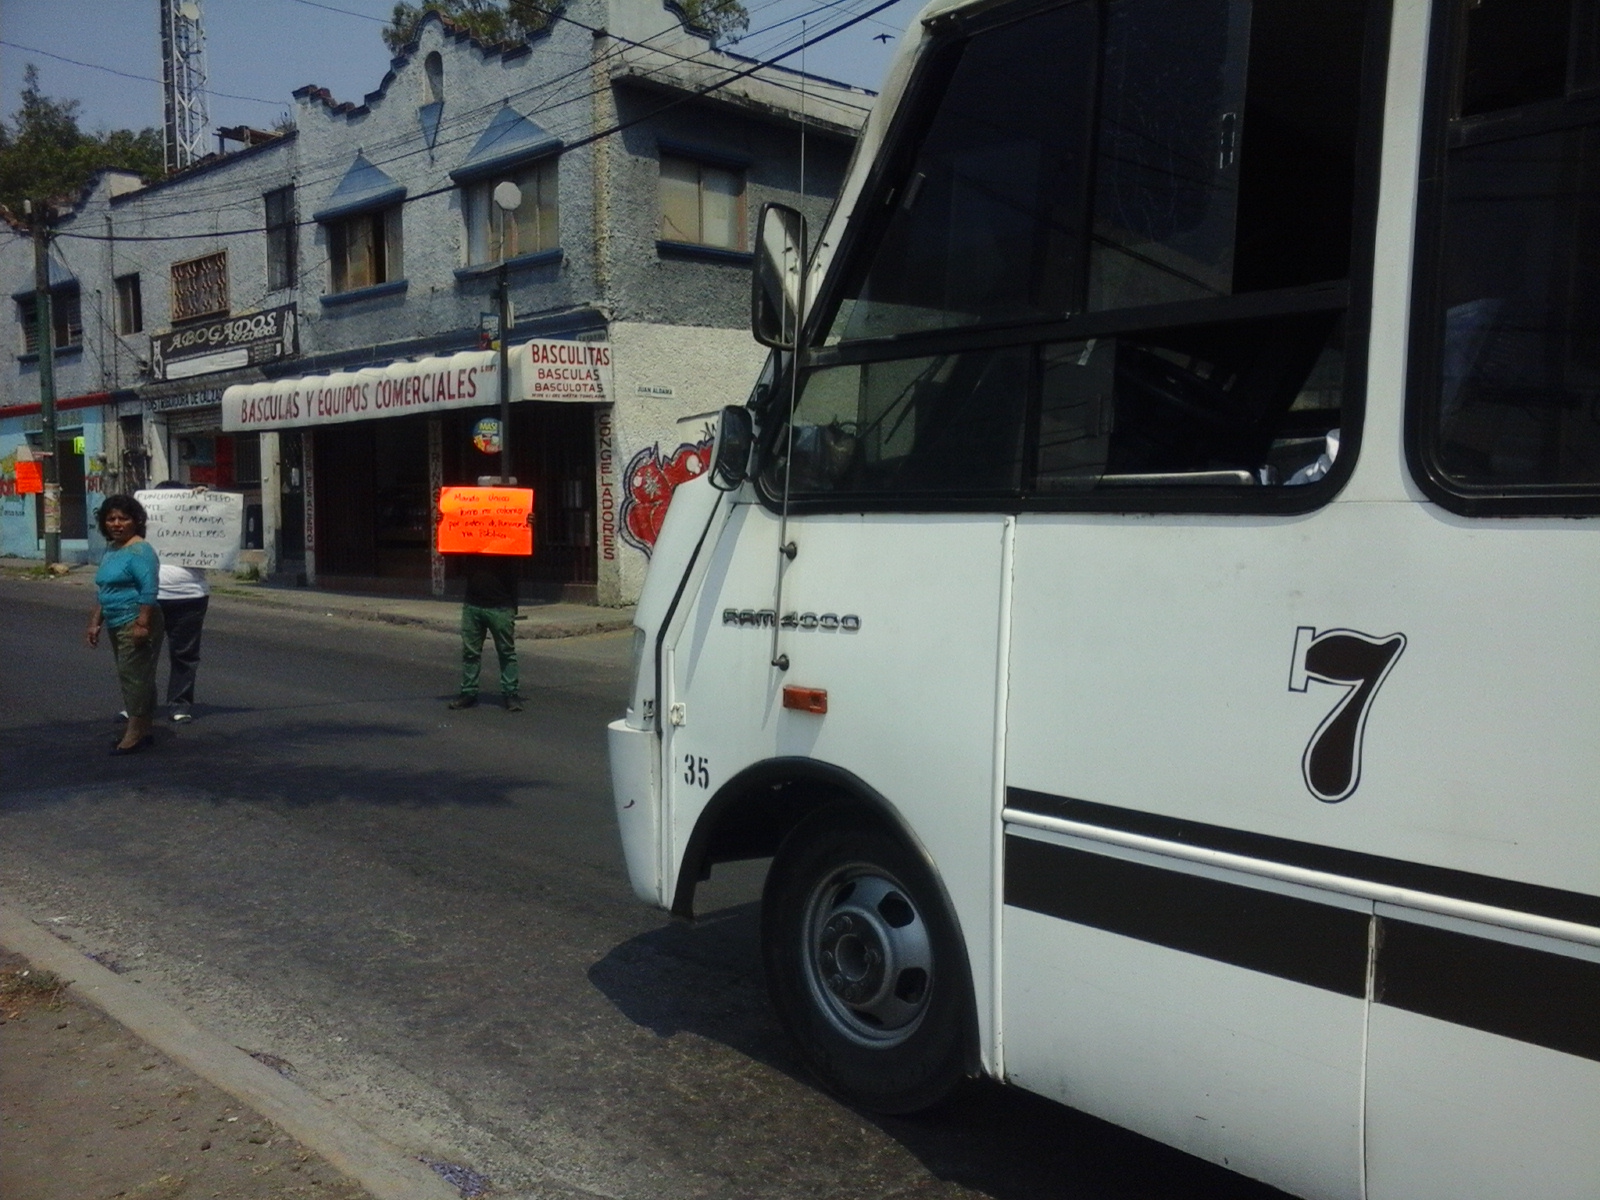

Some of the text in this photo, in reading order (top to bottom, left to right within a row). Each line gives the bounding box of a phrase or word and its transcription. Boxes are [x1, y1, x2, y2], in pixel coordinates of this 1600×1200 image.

[167, 312, 277, 352] ABOGADOS
[532, 344, 610, 366] BASCULITAS
[535, 382, 603, 393] BASCULOTAS
[538, 368, 600, 381] BASCULAS
[241, 391, 300, 424] BASCULAS
[306, 389, 316, 417] Y
[318, 382, 369, 416] EQUIPOS
[375, 366, 478, 411] COMERCIALES
[599, 413, 615, 560] CONGELADORES
[780, 611, 861, 631] 4000
[1288, 626, 1407, 804] 7
[684, 753, 710, 790] 35
